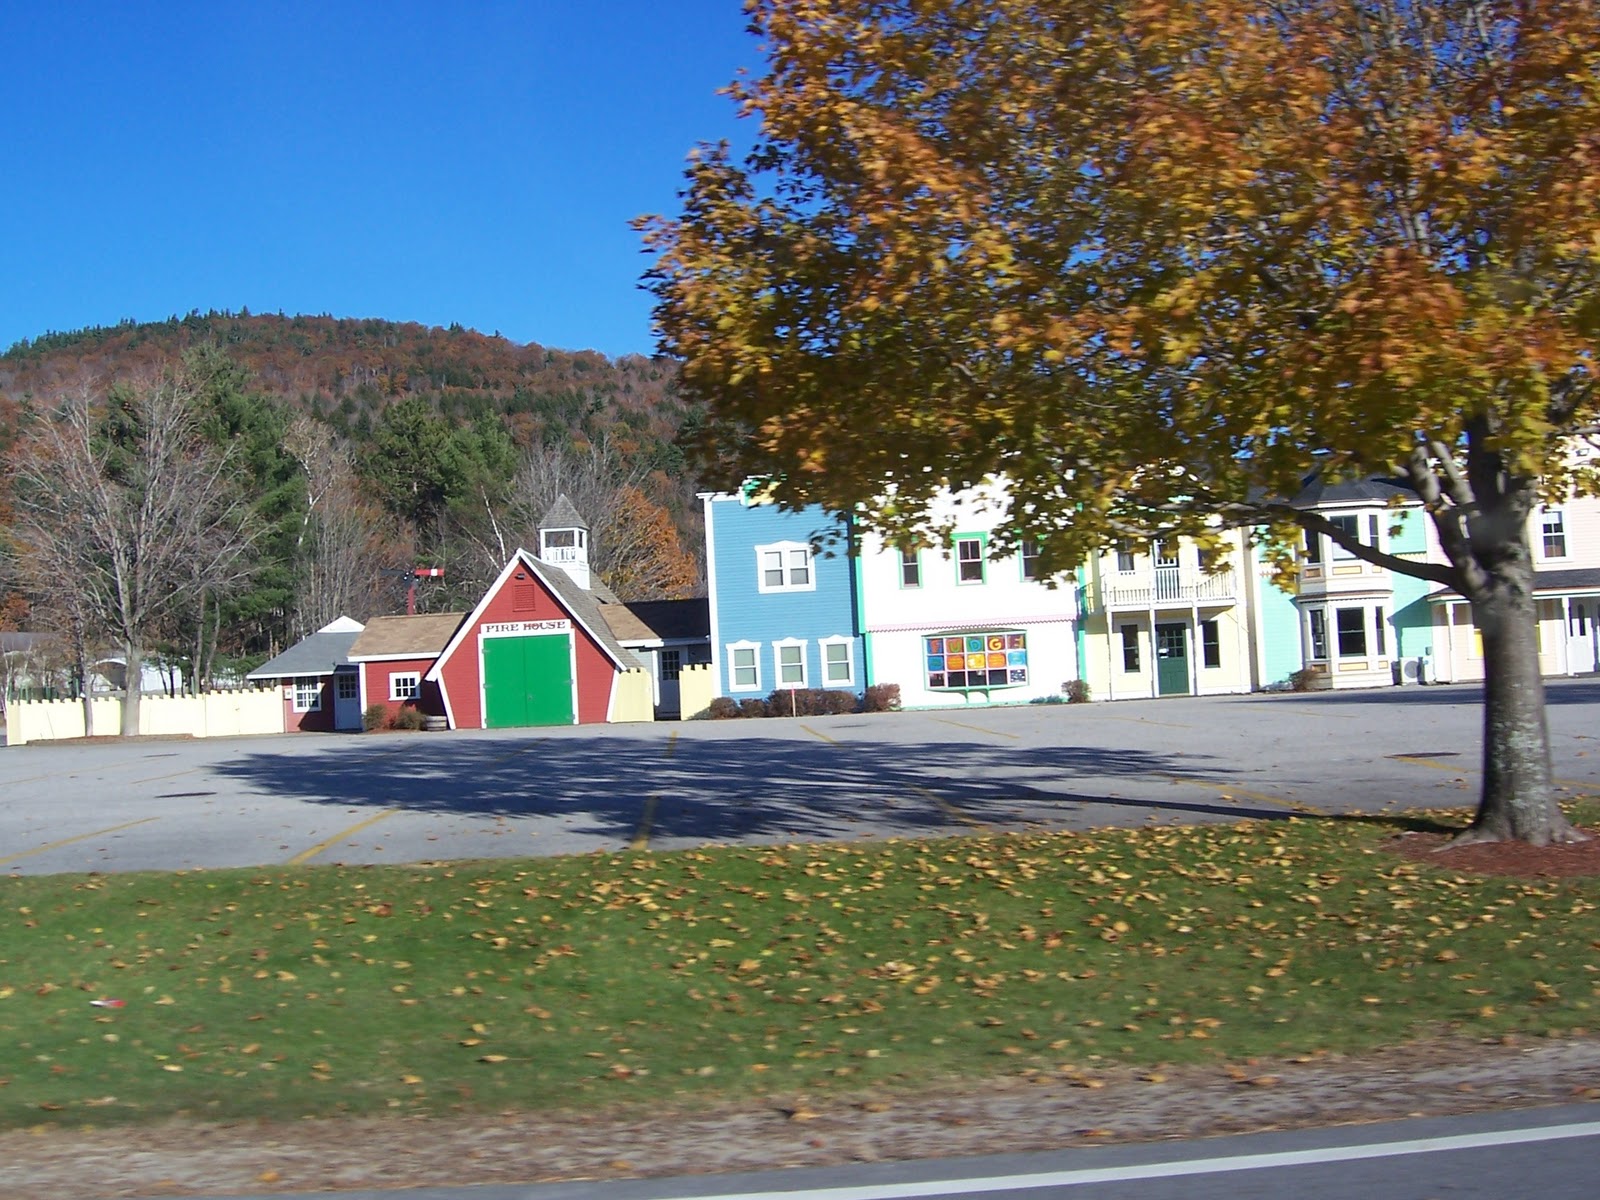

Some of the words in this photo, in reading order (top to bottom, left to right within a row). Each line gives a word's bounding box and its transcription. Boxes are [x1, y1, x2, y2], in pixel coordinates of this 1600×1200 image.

[486, 623, 519, 633] FIRE
[523, 621, 566, 631] HOUSE
[930, 635, 1022, 654] FUDGE
